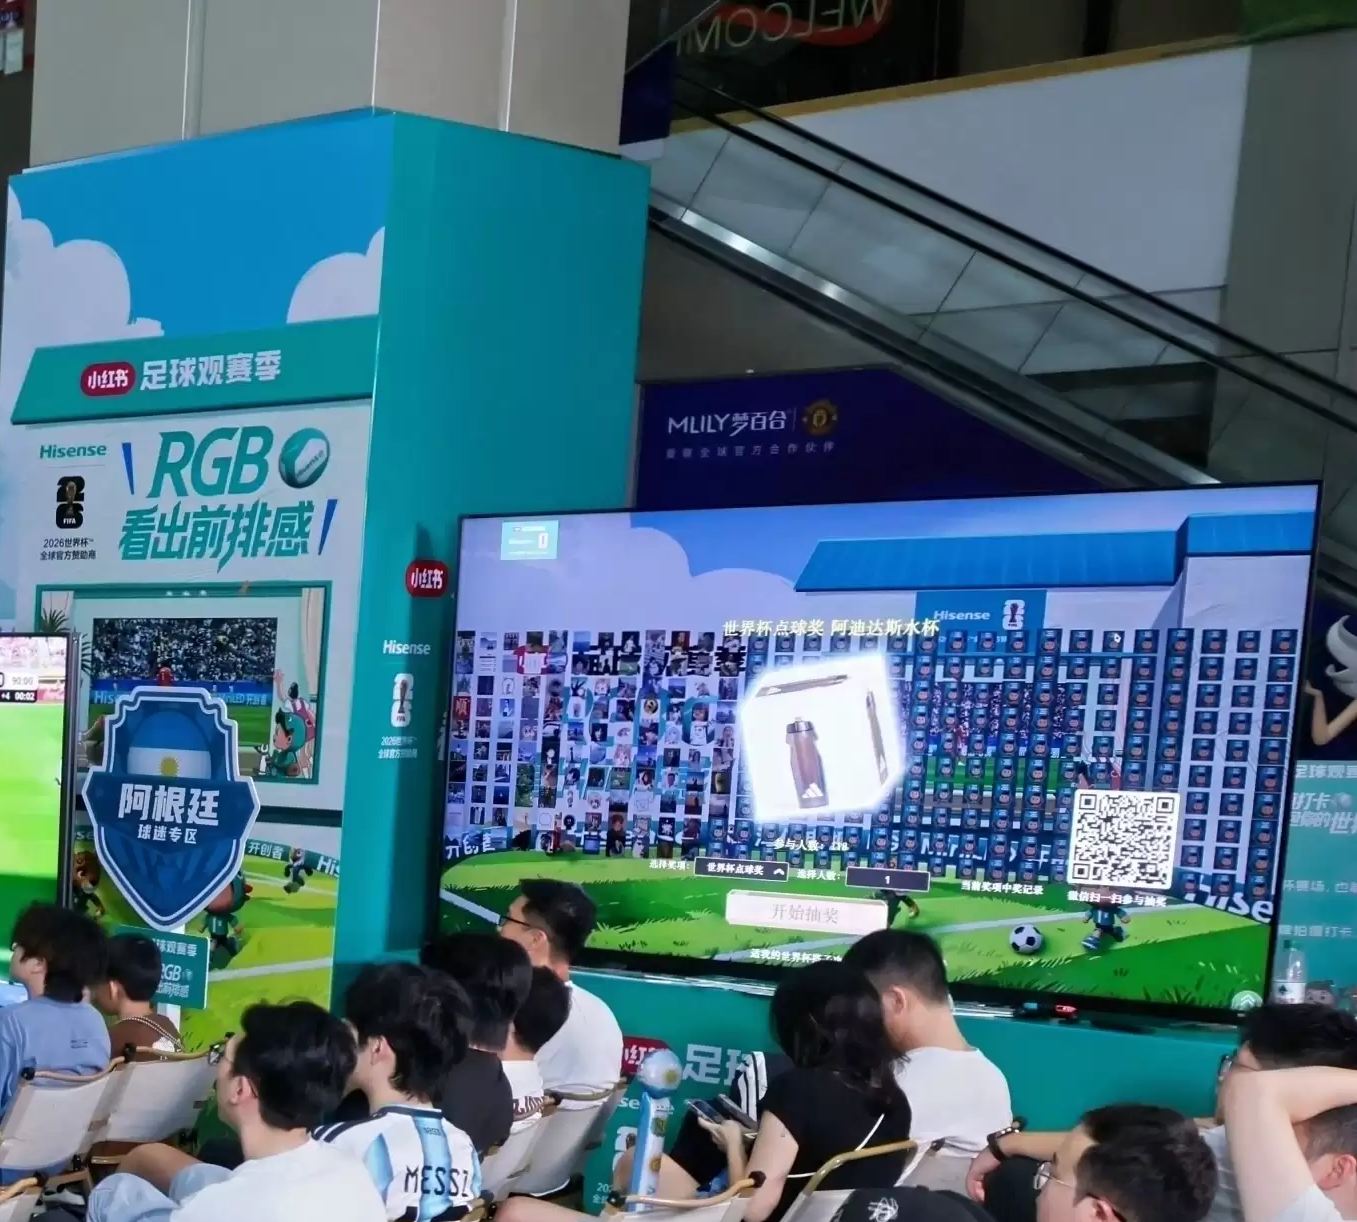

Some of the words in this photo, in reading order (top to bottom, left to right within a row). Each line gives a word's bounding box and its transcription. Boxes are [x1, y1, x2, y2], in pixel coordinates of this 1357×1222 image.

[87, 368, 129, 389] 小红书
[140, 350, 282, 391] 足球观赛季
[39, 444, 107, 460] Hisense
[146, 425, 275, 499] RGB
[118, 500, 315, 575] 看出前排感
[39, 550, 97, 561] 全球官方赞助商
[411, 567, 444, 589] 小红书
[933, 609, 991, 621] Hisense
[722, 618, 824, 638] 世界杯点球奖
[830, 617, 941, 637] 阿迪达斯水杯
[382, 639, 431, 656] Hisense
[14, 691, 35, 701] 00:02
[117, 783, 221, 827] 阿根廷
[137, 823, 198, 845] 球迷专区
[247, 841, 284, 860] 开创者
[706, 862, 765, 876] 世界杯点球奖
[961, 880, 1044, 896] 当前奖项中奖记录
[1067, 890, 1167, 908] 微信扫一扫参与抽奖
[772, 903, 839, 925] 开始抽奖
[404, 1164, 470, 1198] MESSI
